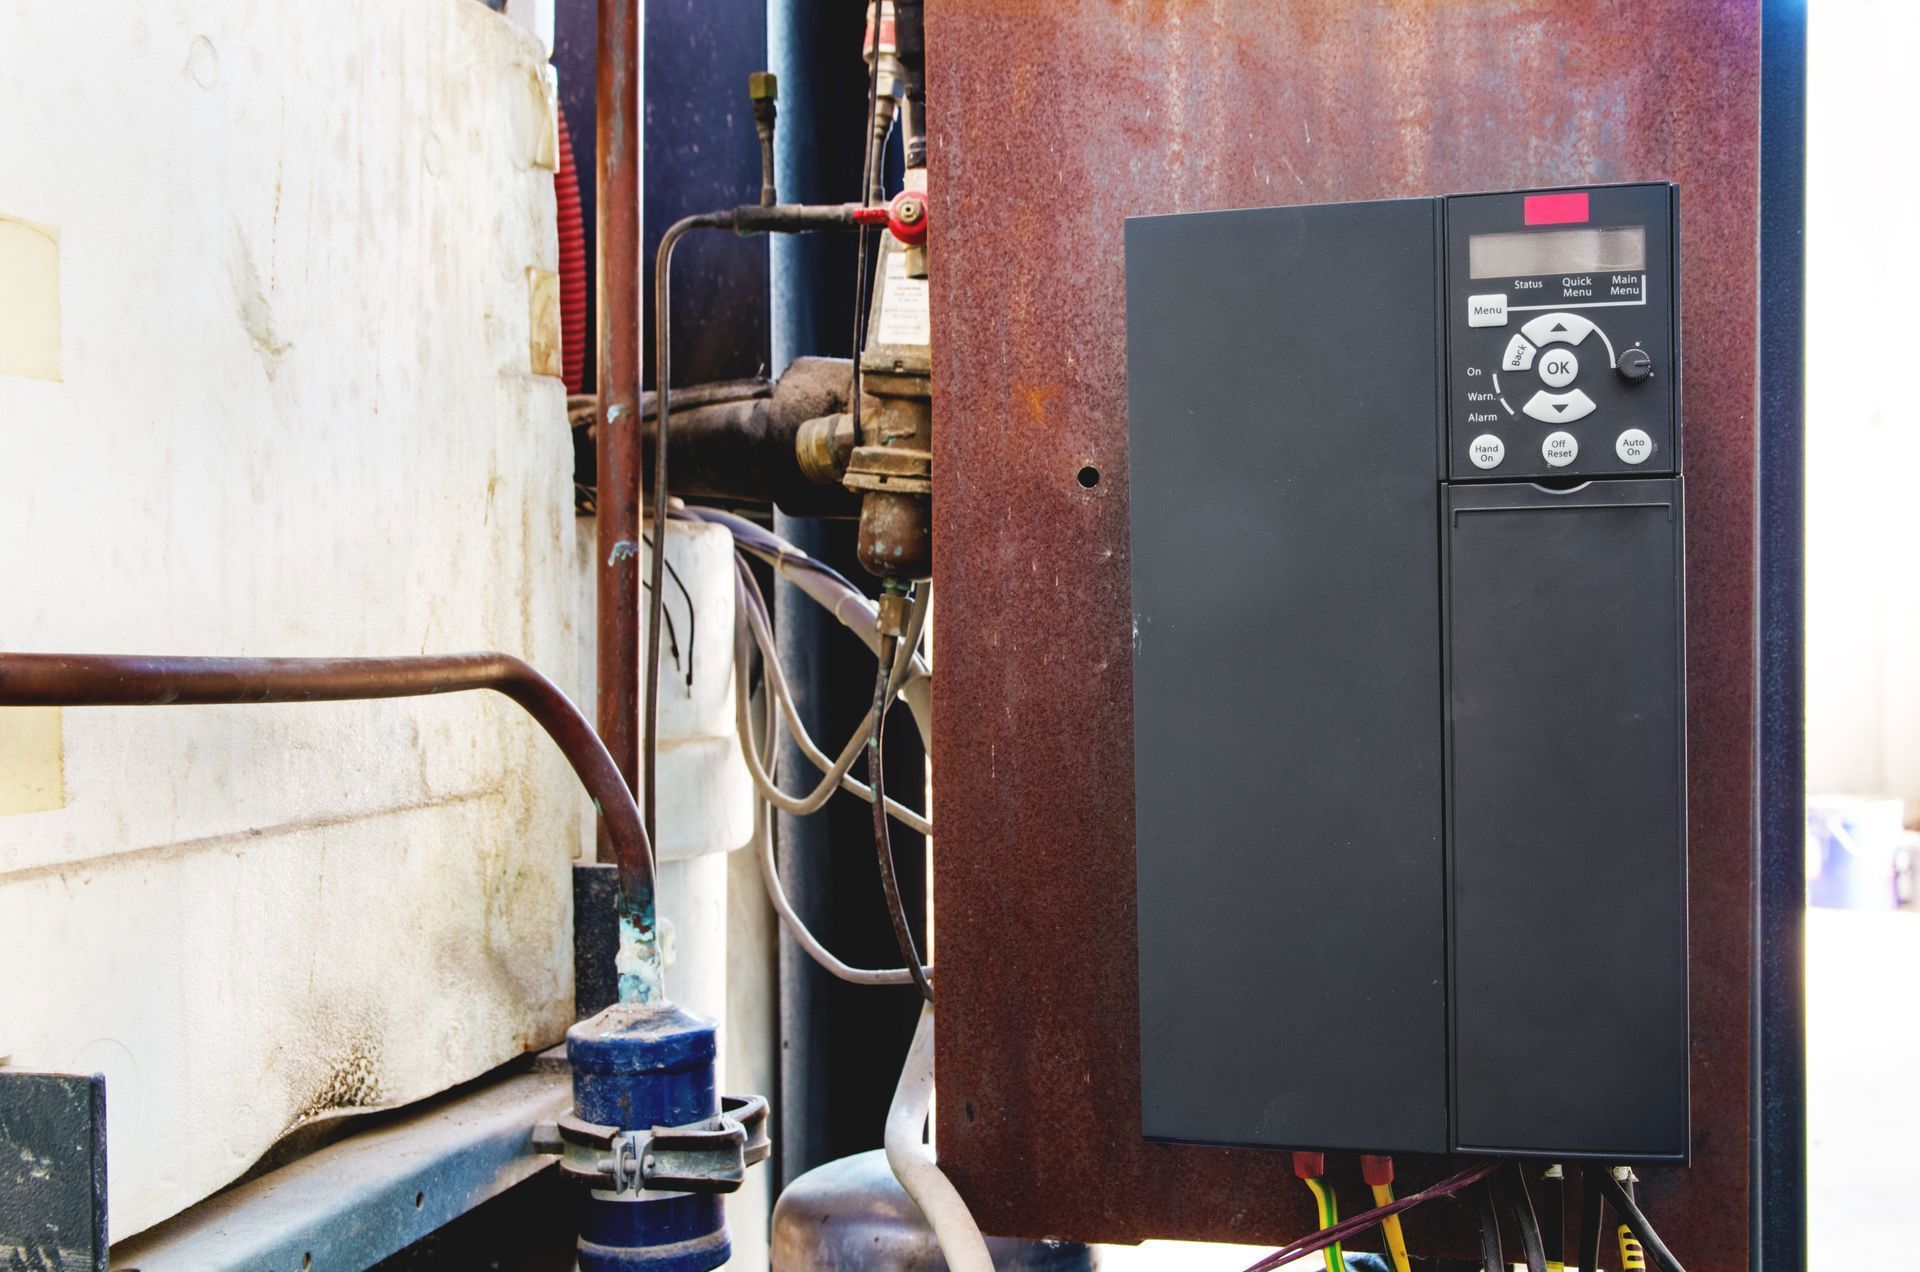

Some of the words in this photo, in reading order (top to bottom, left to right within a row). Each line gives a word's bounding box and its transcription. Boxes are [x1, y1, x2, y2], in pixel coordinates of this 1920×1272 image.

[1563, 277, 1591, 287] Quick
[1613, 274, 1636, 283] Main
[1515, 280, 1542, 289] Status
[1564, 288, 1591, 297] Menu
[1611, 286, 1639, 295] Menu
[1474, 306, 1502, 315] Menu
[1512, 345, 1526, 366] Back
[1467, 368, 1481, 376] On
[1547, 362, 1569, 374] OK
[1468, 393, 1495, 401] Warn.
[1468, 413, 1497, 422] Alarm
[1552, 440, 1565, 448] Off
[1623, 438, 1644, 447] Auto
[1476, 444, 1498, 453] Hand
[1627, 448, 1640, 456] On
[1481, 454, 1493, 462] On
[1548, 449, 1571, 458] Reset
